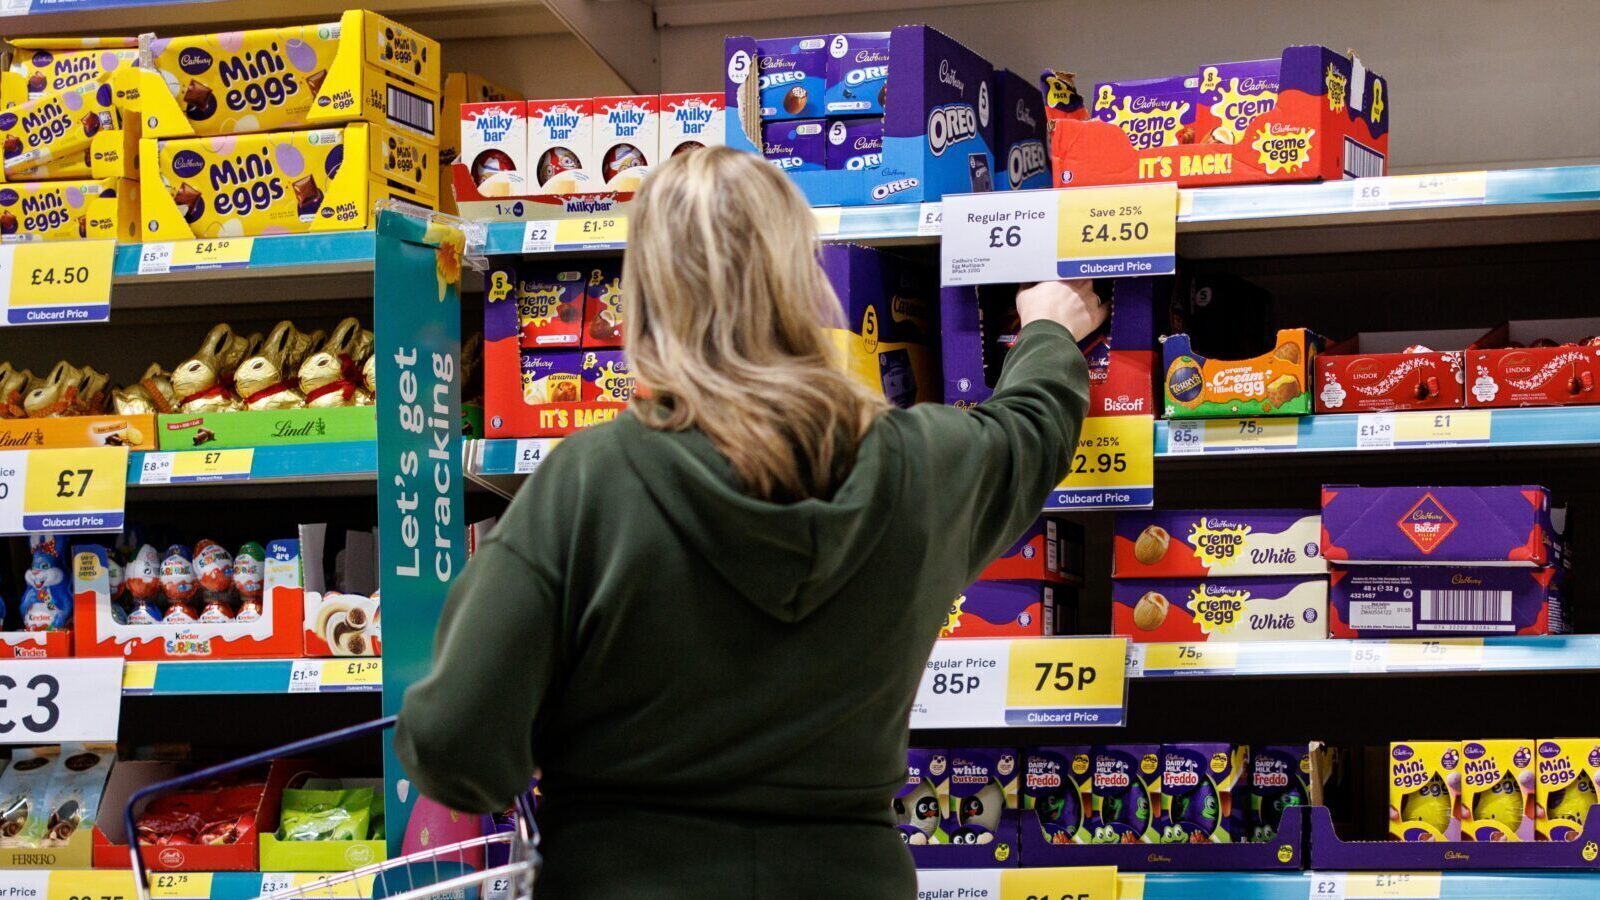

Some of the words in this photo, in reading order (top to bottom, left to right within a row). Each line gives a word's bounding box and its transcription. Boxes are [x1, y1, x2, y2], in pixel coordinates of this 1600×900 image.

[835, 38, 843, 49] 5
[55, 53, 97, 77] Mini
[180, 55, 212, 67] Cadbury
[219, 42, 285, 88] Mini
[734, 55, 745, 71] 5
[760, 56, 797, 70] Cadbury
[759, 70, 806, 89] OREO
[939, 59, 965, 98] Cadbury
[1207, 72, 1213, 82] 8
[226, 73, 298, 112] eggs
[1239, 78, 1280, 96] Cadbury
[332, 89, 353, 103] Mini
[981, 89, 987, 108] 5
[1102, 90, 1108, 100] 8
[333, 99, 355, 110] eggs
[1132, 96, 1171, 110] Cadbury
[1225, 99, 1275, 121] crem
[22, 97, 63, 133] Mini
[542, 113, 579, 128] Milky
[608, 109, 645, 125] Milky
[675, 107, 713, 122] Milky
[476, 115, 512, 131] Milky
[615, 123, 638, 137] bar
[682, 120, 705, 134] bar
[834, 124, 842, 135] 5
[1271, 124, 1301, 134] Cadbury
[28, 114, 72, 147] eggs
[483, 129, 506, 142] bar
[550, 126, 572, 139] bar
[929, 106, 977, 156] OREO
[1129, 130, 1165, 151] egg
[1262, 138, 1306, 153] creme
[174, 157, 205, 168] Cadbury
[1269, 148, 1299, 163] egg
[209, 146, 273, 192] Mini
[1009, 142, 1047, 190] OREO
[1139, 156, 1173, 179] IT'S
[1180, 153, 1233, 177] BACK!
[871, 178, 919, 202] OREO
[1361, 186, 1381, 198] £6
[22, 188, 62, 216] Mini
[214, 178, 284, 217] eggs
[336, 201, 356, 216] Mini
[566, 200, 613, 213] Milkybar
[1089, 207, 1116, 219] Save
[1119, 206, 1143, 217] 25%
[24, 208, 70, 232] eggs
[337, 210, 359, 221] eggs
[926, 212, 944, 224] £4
[967, 211, 1012, 225] Regular
[1015, 209, 1046, 220] Price
[582, 220, 615, 233] £1.50
[1081, 221, 1149, 244] £4.50
[530, 229, 548, 240] £2
[989, 225, 1022, 249] £6
[195, 241, 230, 254] £4.50
[143, 252, 169, 262] £5.50
[1079, 263, 1128, 274] Clubcard
[1130, 261, 1152, 272] Price
[31, 266, 89, 286] £4.50
[496, 277, 503, 289] 5
[27, 311, 65, 321] Clubcard
[66, 311, 89, 320] Price
[521, 305, 549, 318] egg
[867, 311, 874, 335] 5
[586, 354, 593, 364] 5
[1224, 366, 1253, 374] orange
[1352, 371, 1378, 381] LINDOR
[1505, 365, 1531, 375] LINDOR
[548, 374, 579, 382] Caramel
[393, 346, 425, 435] get
[1213, 384, 1233, 394] filled
[1233, 380, 1265, 397] egg
[1104, 399, 1144, 411] Biscoff
[540, 409, 569, 429] IT'S
[1433, 415, 1451, 428] £1
[271, 421, 315, 437] Lindt
[1239, 421, 1264, 435] 75p
[1361, 424, 1391, 437] £1.20
[1078, 440, 1093, 448] ve
[1096, 437, 1120, 447] 25%
[1174, 430, 1199, 444] 85p
[205, 453, 221, 463] £7
[523, 449, 541, 461] £4
[143, 461, 169, 472] £8.50
[427, 351, 454, 582] cracking
[1070, 453, 1127, 474] 2.95
[56, 469, 94, 498] £7
[1058, 493, 1103, 504] Clubcard
[1105, 492, 1130, 503] Price
[394, 450, 421, 578] Let's
[1412, 510, 1444, 522] Cadbury
[42, 518, 80, 527] Clubcard
[82, 516, 104, 525] Price
[1207, 519, 1238, 530] Cadbury
[1414, 523, 1441, 533] Biscoff
[1198, 533, 1243, 548] creme
[276, 551, 290, 560] are
[1205, 544, 1235, 559] egg
[1250, 548, 1297, 564] White
[1451, 573, 1483, 586] Cadbury
[1206, 585, 1236, 596] Cadbury
[1197, 600, 1242, 614] creme
[1204, 610, 1234, 626] egg
[1249, 613, 1296, 631] White
[166, 640, 211, 654] SURPRISE
[1178, 647, 1203, 660] 75p
[1354, 649, 1381, 662] 85p
[347, 662, 378, 674] £1.30
[926, 658, 962, 671] egular
[966, 657, 996, 669] Price
[293, 670, 319, 681] £1.50
[1034, 662, 1097, 692] 75p
[932, 673, 981, 695] 85p
[1027, 711, 1072, 722] Clubcard
[1073, 711, 1099, 722] Price
[952, 765, 988, 775] white
[1392, 758, 1424, 776] Mini
[1464, 757, 1496, 774] Mini
[1540, 756, 1571, 773] Mini
[952, 775, 989, 784] buttons
[1027, 775, 1060, 787] Freddo
[1095, 774, 1128, 786] Freddo
[1164, 773, 1197, 785] Freddo
[1254, 774, 1287, 786] Freddo
[1394, 771, 1428, 787] eggs
[1466, 770, 1500, 786] eggs
[1540, 769, 1575, 785] eggs
[12, 853, 56, 866] FERRERO
[1444, 851, 1469, 861] Cadbury
[157, 875, 188, 887] £2.75
[1317, 881, 1336, 893] £2
[10, 887, 37, 897] Price
[918, 889, 954, 900] egular
[957, 888, 989, 898] Price
